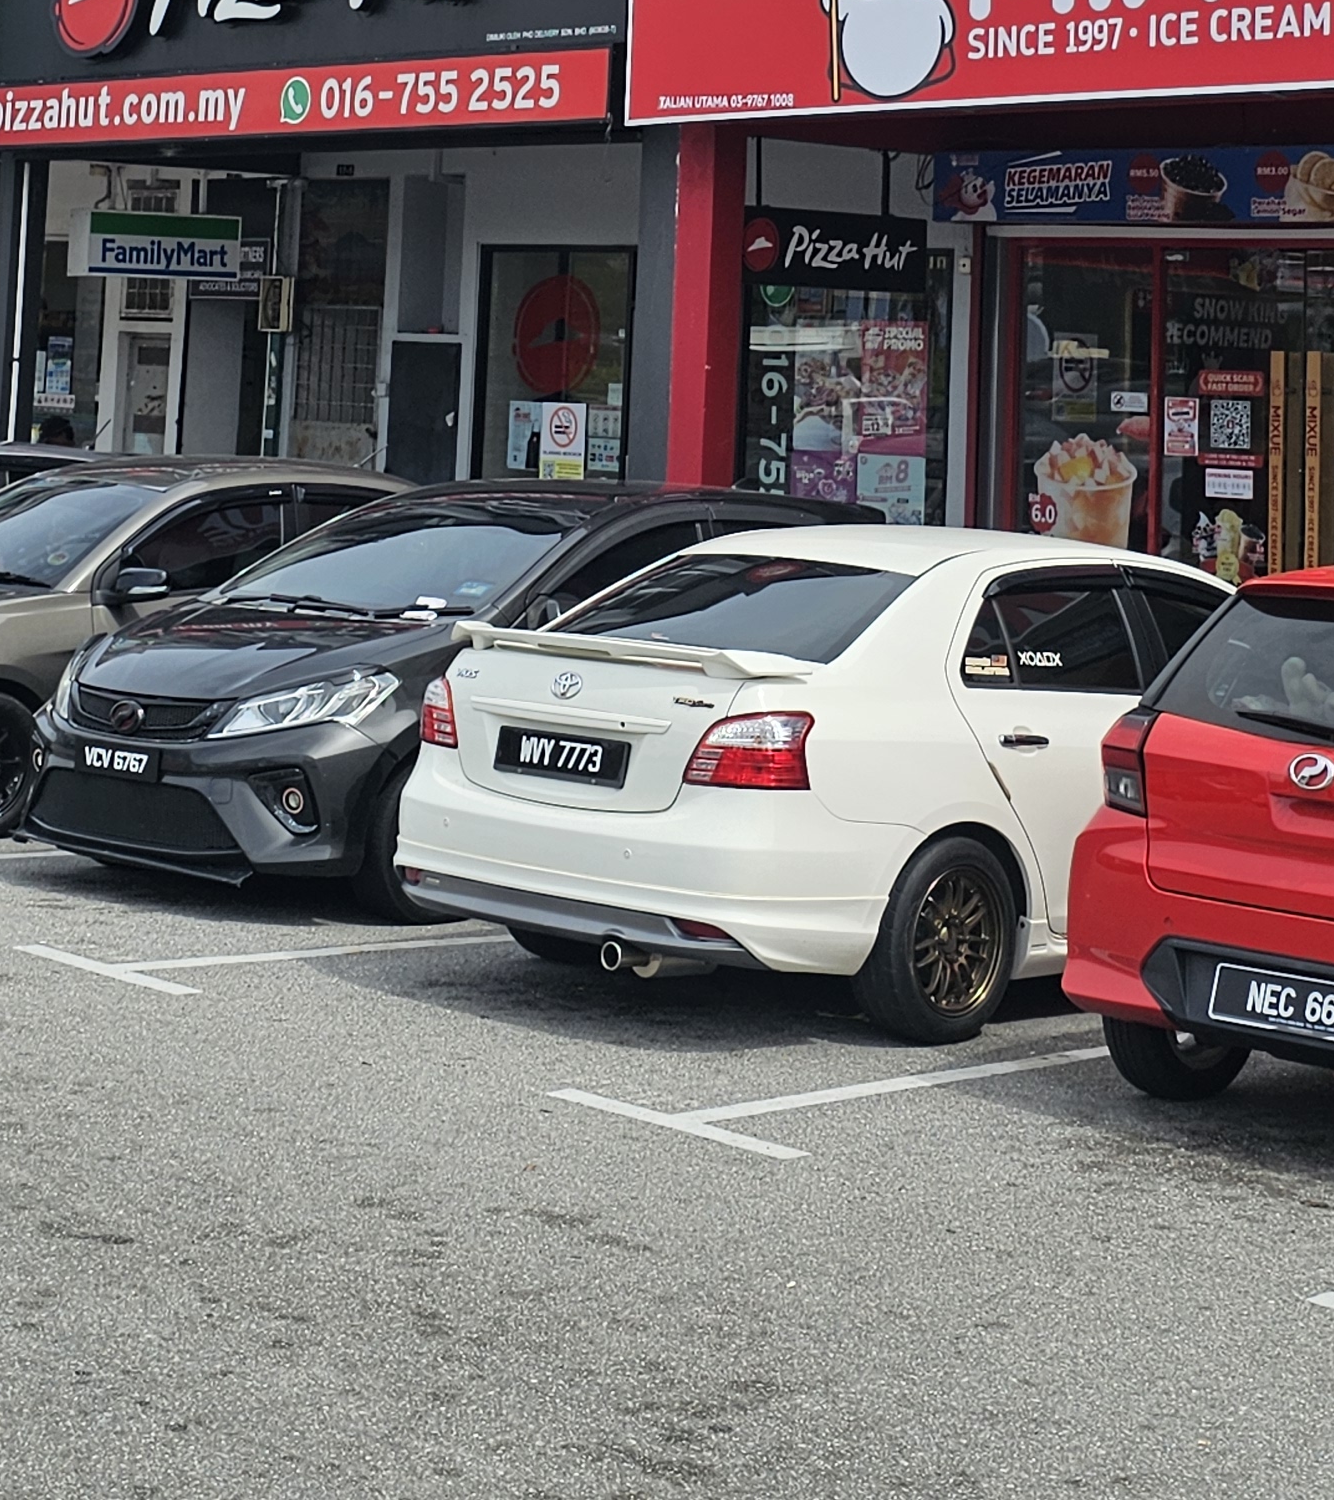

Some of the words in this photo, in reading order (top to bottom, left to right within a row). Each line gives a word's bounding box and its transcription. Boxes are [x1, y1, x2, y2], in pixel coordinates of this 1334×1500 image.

[967, 22, 1055, 60] SINCE
[1065, 17, 1123, 53] 1997
[1149, 10, 1199, 47] ICE
[1209, 1, 1331, 43] CREAM
[321, 69, 459, 121] 016-755
[467, 64, 561, 113] 2525
[658, 95, 694, 110] TALIAN
[694, 94, 729, 109] UTAMA
[730, 93, 768, 108] 03-9767
[1005, 181, 1110, 207] SELAMANYA
[1006, 161, 1111, 188] KEGEMARAN
[101, 237, 229, 270] FamilyMart
[784, 225, 859, 269] Pizza
[861, 232, 918, 271] Hut
[1193, 297, 1245, 322] SNOW
[1270, 404, 1281, 457] MIXUE
[1307, 405, 1318, 457] MIXUE
[84, 745, 113, 770] VCV
[114, 749, 150, 775] 6767
[520, 734, 553, 767] WVY
[557, 739, 603, 774] 7773
[1246, 979, 1297, 1019] NEC
